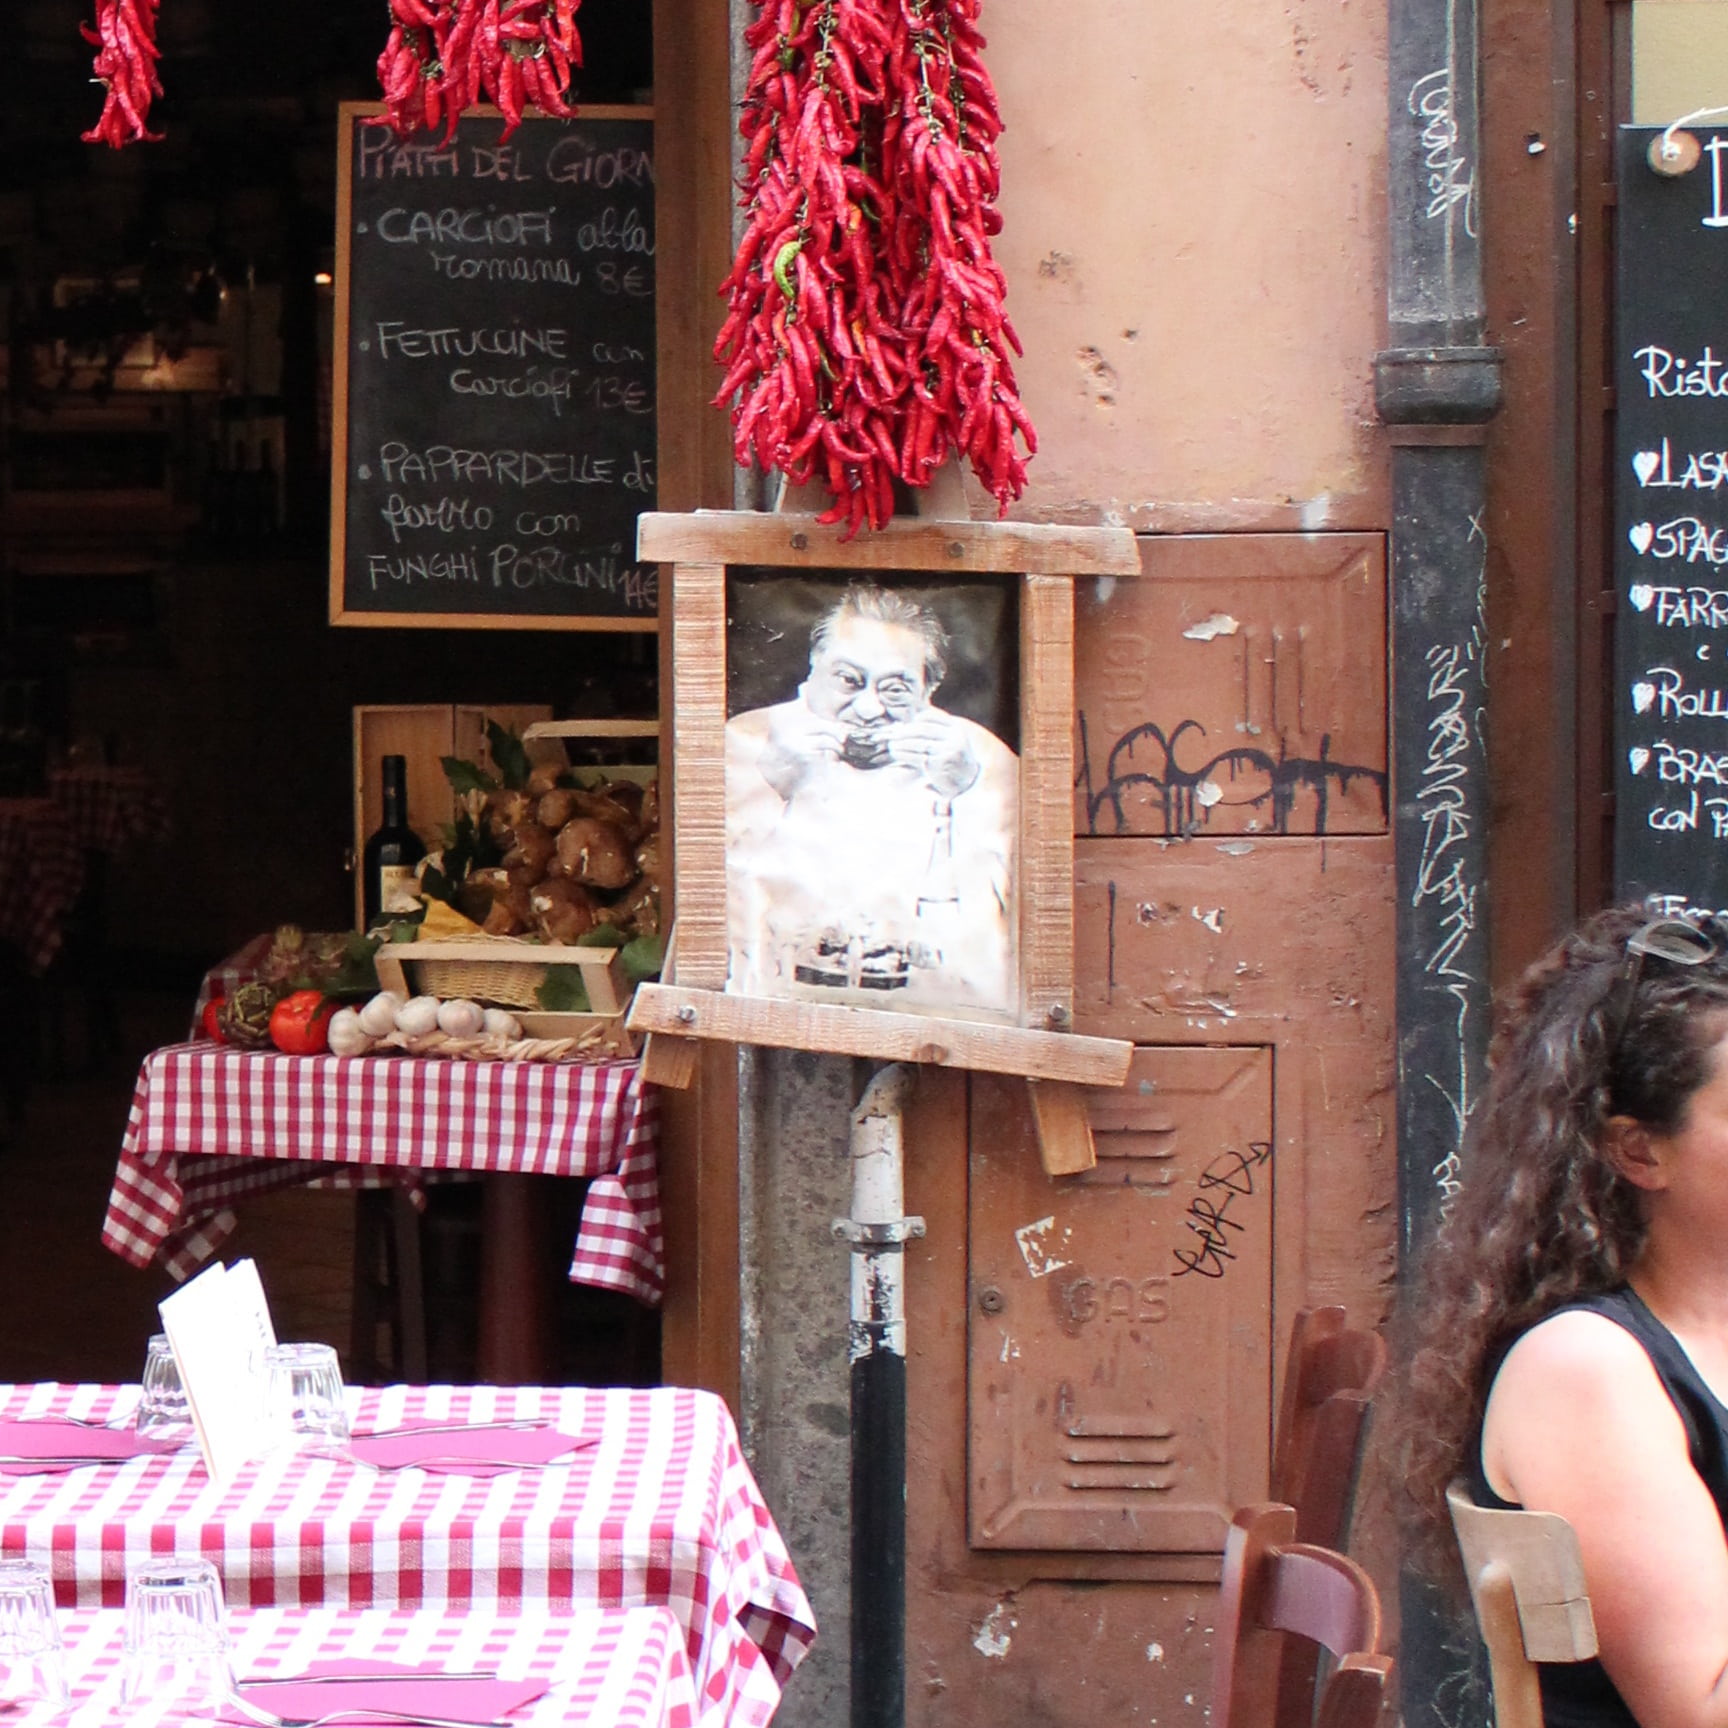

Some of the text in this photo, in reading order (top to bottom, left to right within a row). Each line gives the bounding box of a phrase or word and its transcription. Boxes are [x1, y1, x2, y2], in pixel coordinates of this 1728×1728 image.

[472, 145, 532, 181] DEL
[377, 205, 556, 245] CARCIOFI
[430, 251, 656, 297] romana 8€
[377, 321, 567, 360] FETTUCCINE
[586, 374, 653, 415] 13€
[380, 442, 616, 488] PAPPARDELLE
[517, 511, 581, 536] con
[368, 545, 479, 590] FUNGHI
[489, 543, 623, 593] PORCINI
[1068, 1275, 1171, 1324] GAS
